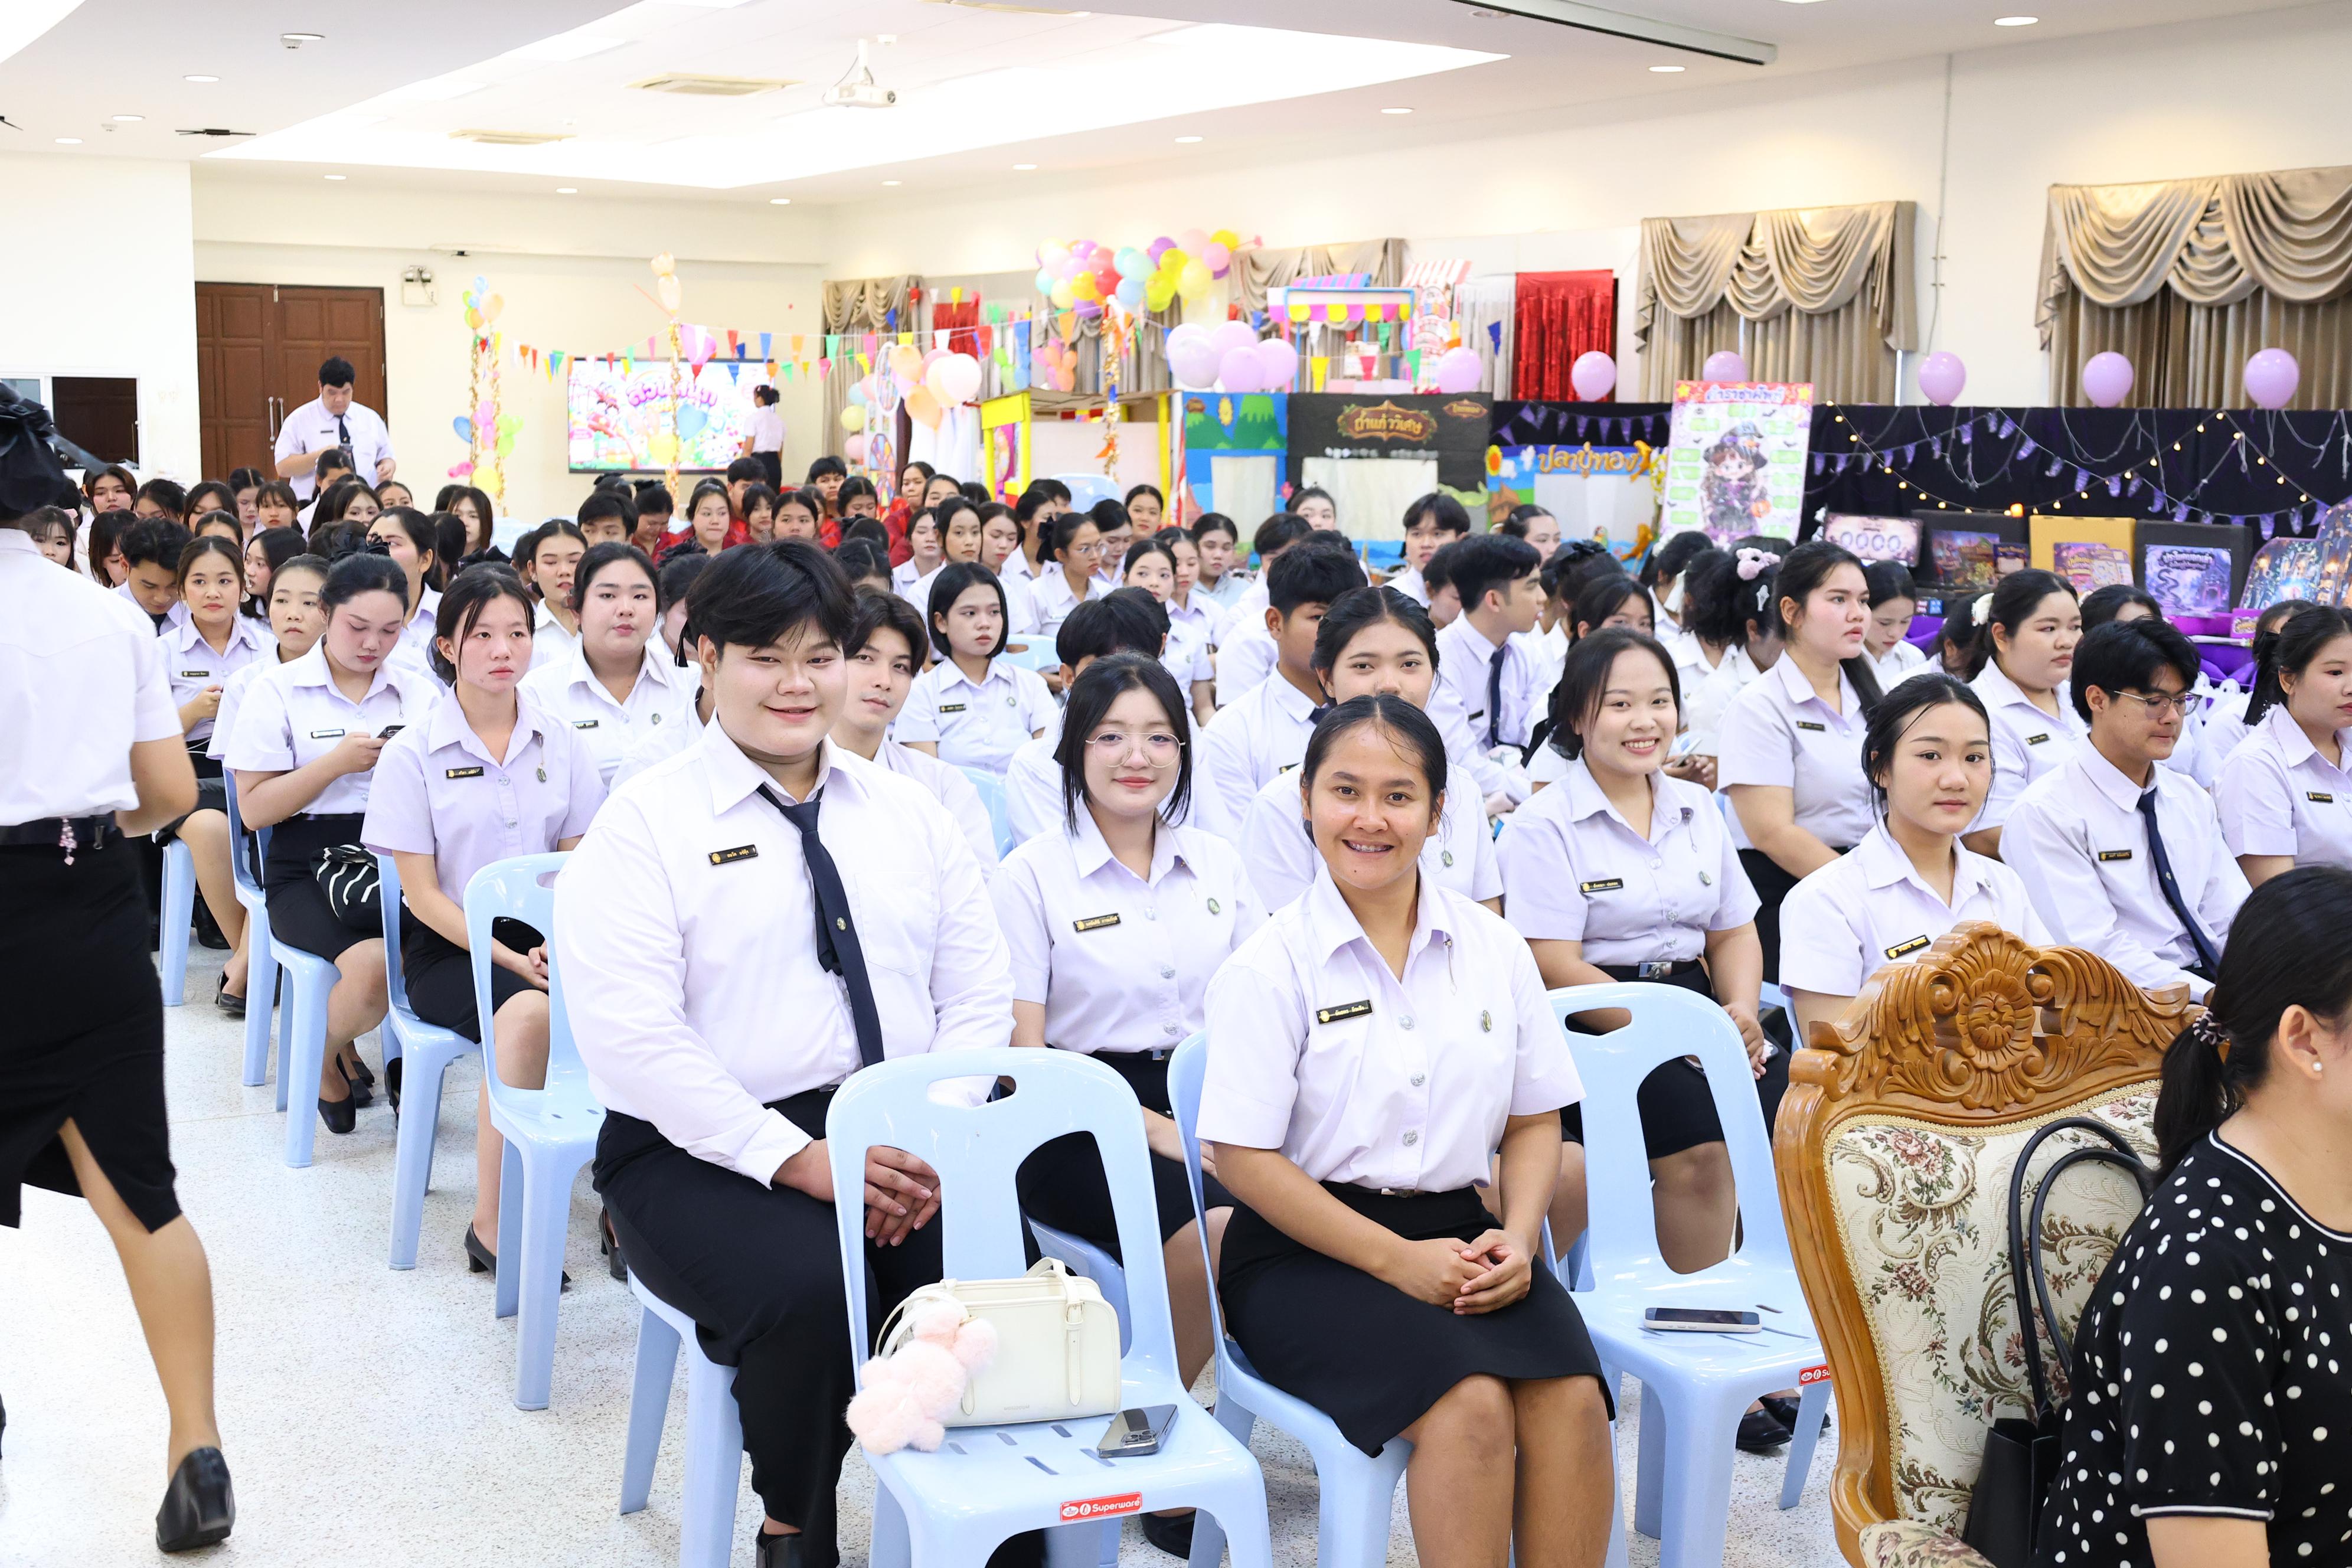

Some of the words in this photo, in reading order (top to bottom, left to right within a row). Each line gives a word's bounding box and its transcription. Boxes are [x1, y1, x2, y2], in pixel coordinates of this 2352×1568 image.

[1538, 441, 1639, 478] ปลาบู่ทอง
[1092, 1500, 1140, 1513] Superware
